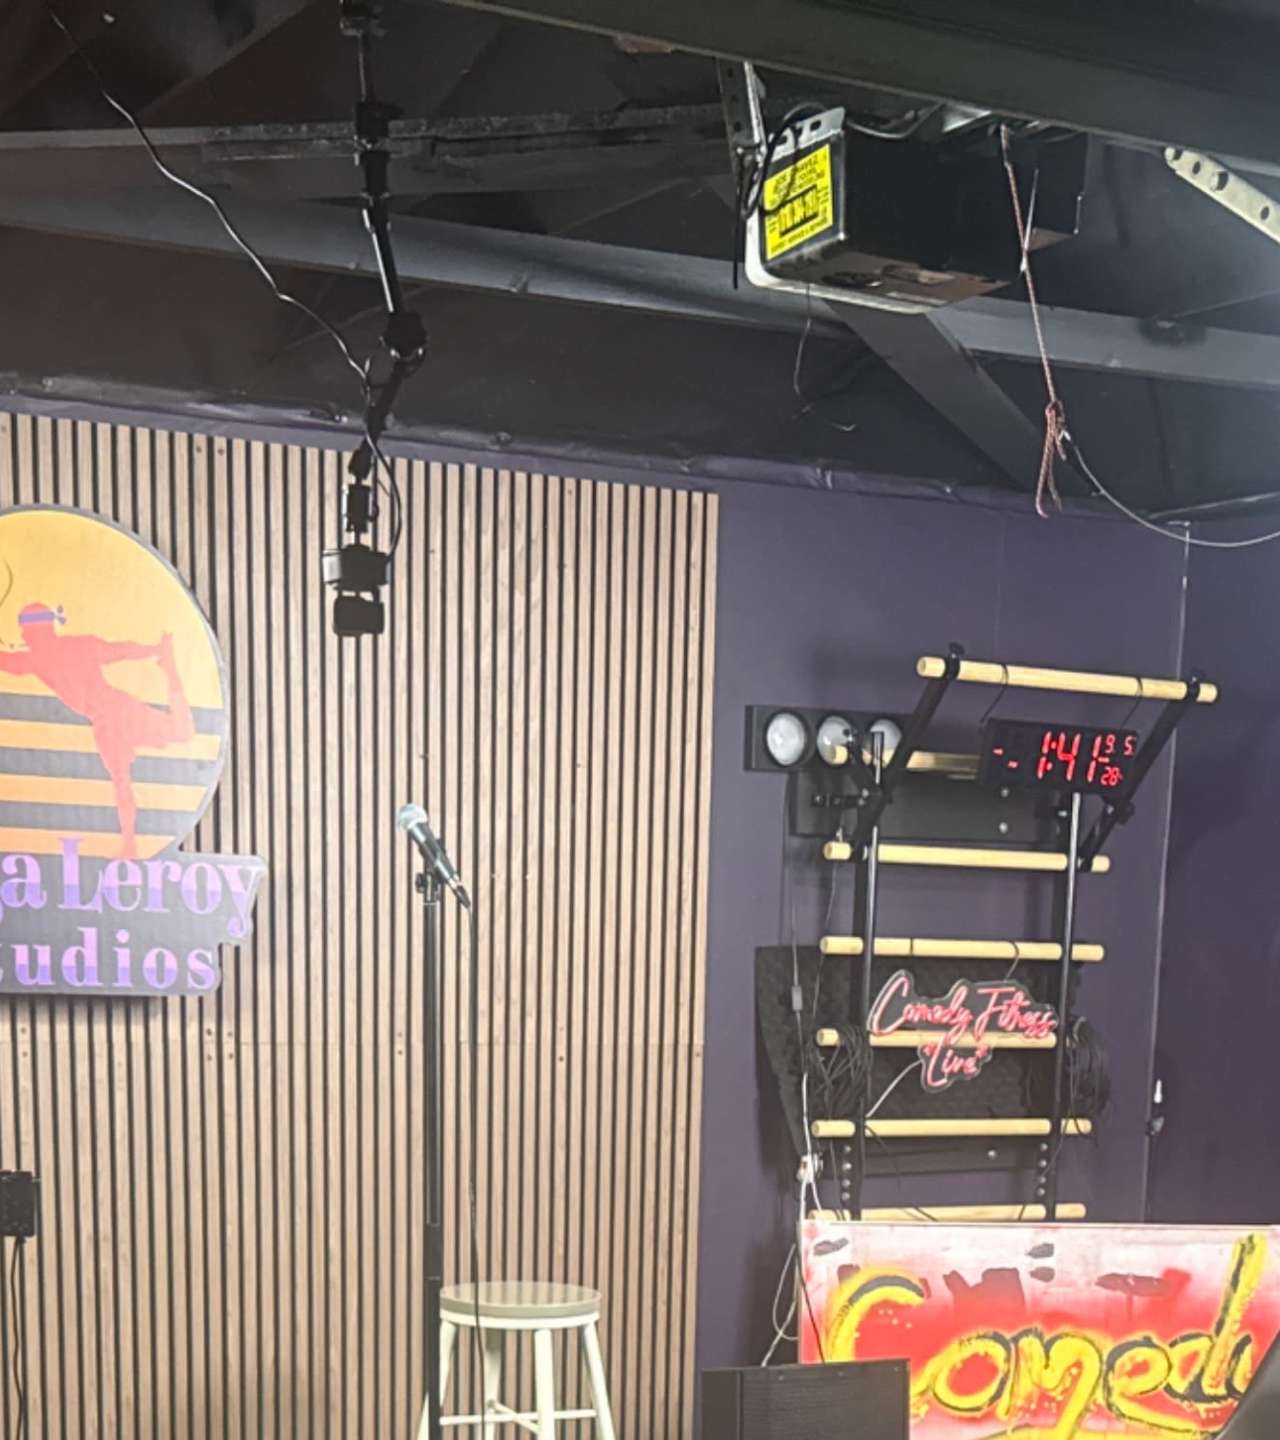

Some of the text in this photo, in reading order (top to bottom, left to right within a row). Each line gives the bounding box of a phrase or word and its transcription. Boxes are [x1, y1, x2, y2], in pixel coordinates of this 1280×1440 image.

[57, 837, 261, 938] Leroy
[872, 976, 1056, 1045] Comedy Fitness
